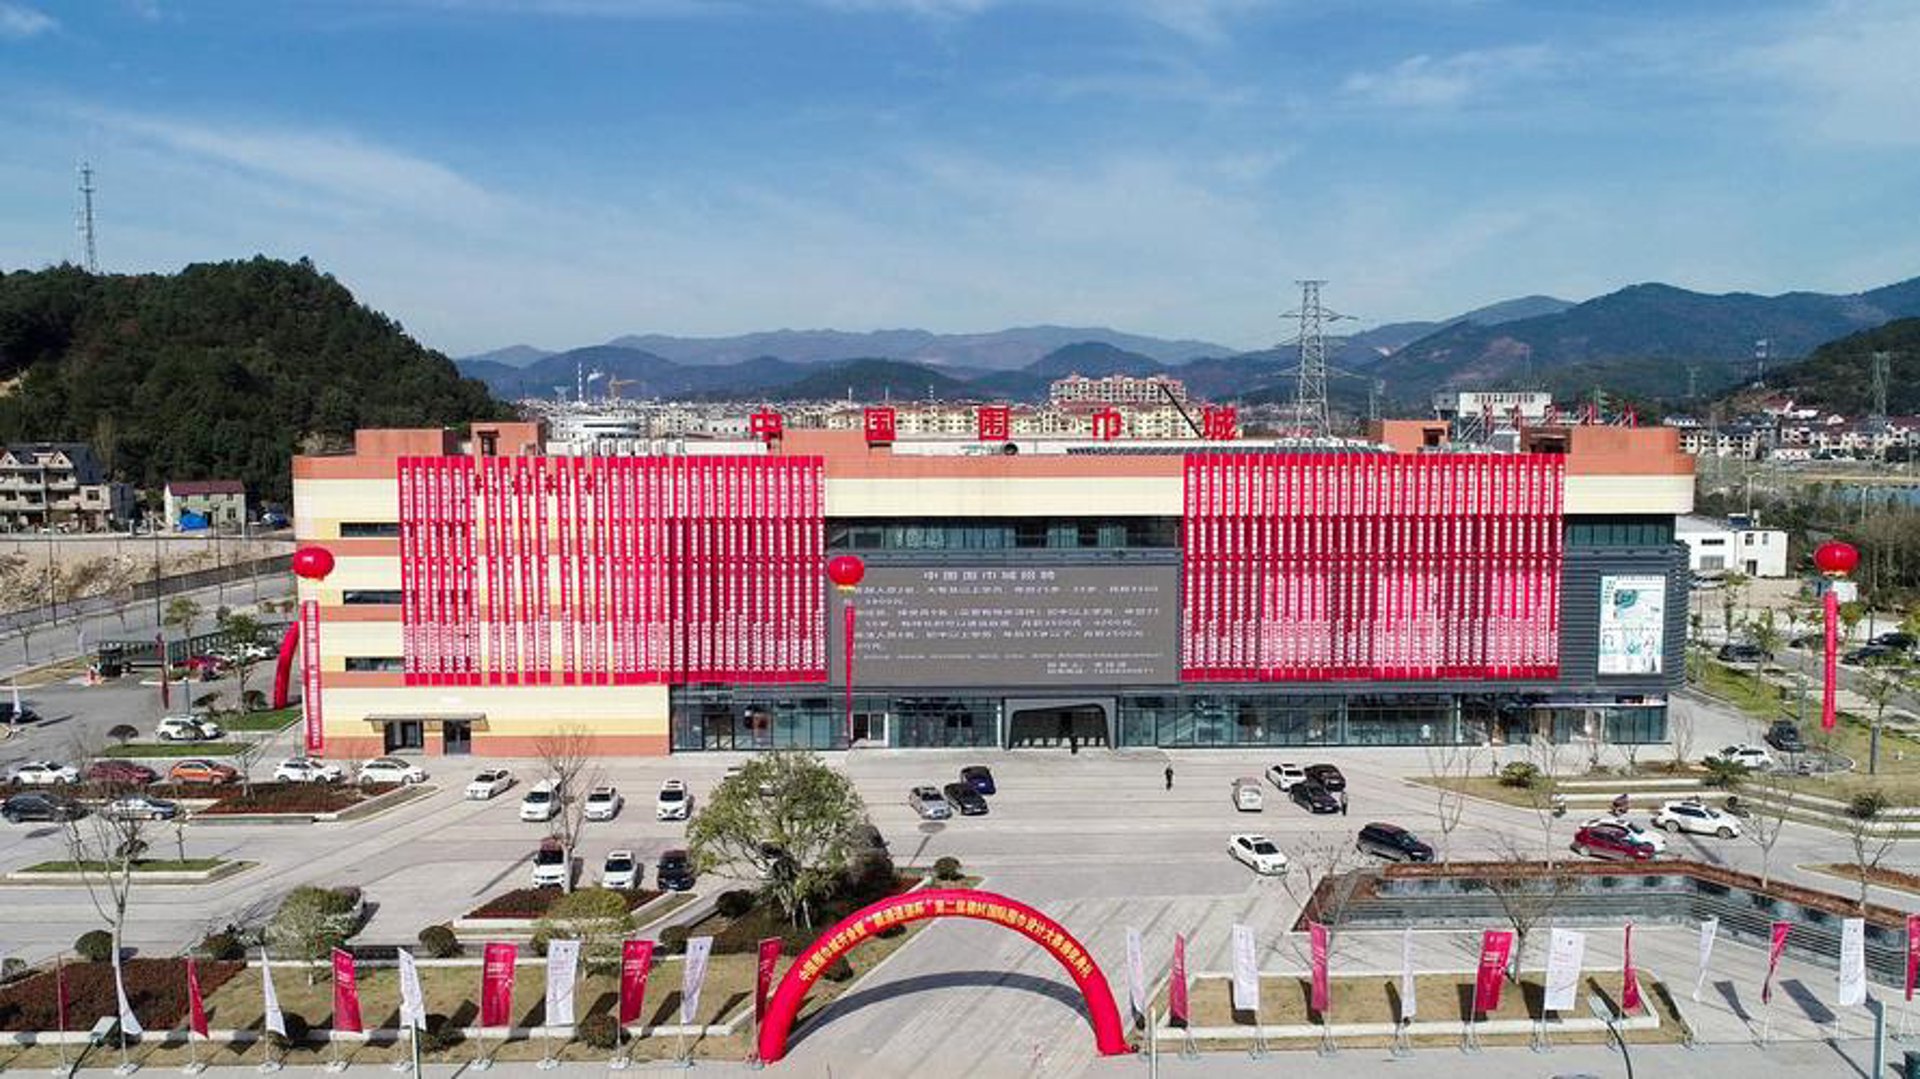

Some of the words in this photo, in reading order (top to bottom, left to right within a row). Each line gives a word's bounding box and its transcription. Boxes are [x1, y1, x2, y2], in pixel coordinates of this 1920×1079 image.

[750, 405, 1238, 441] 中国围巾城
